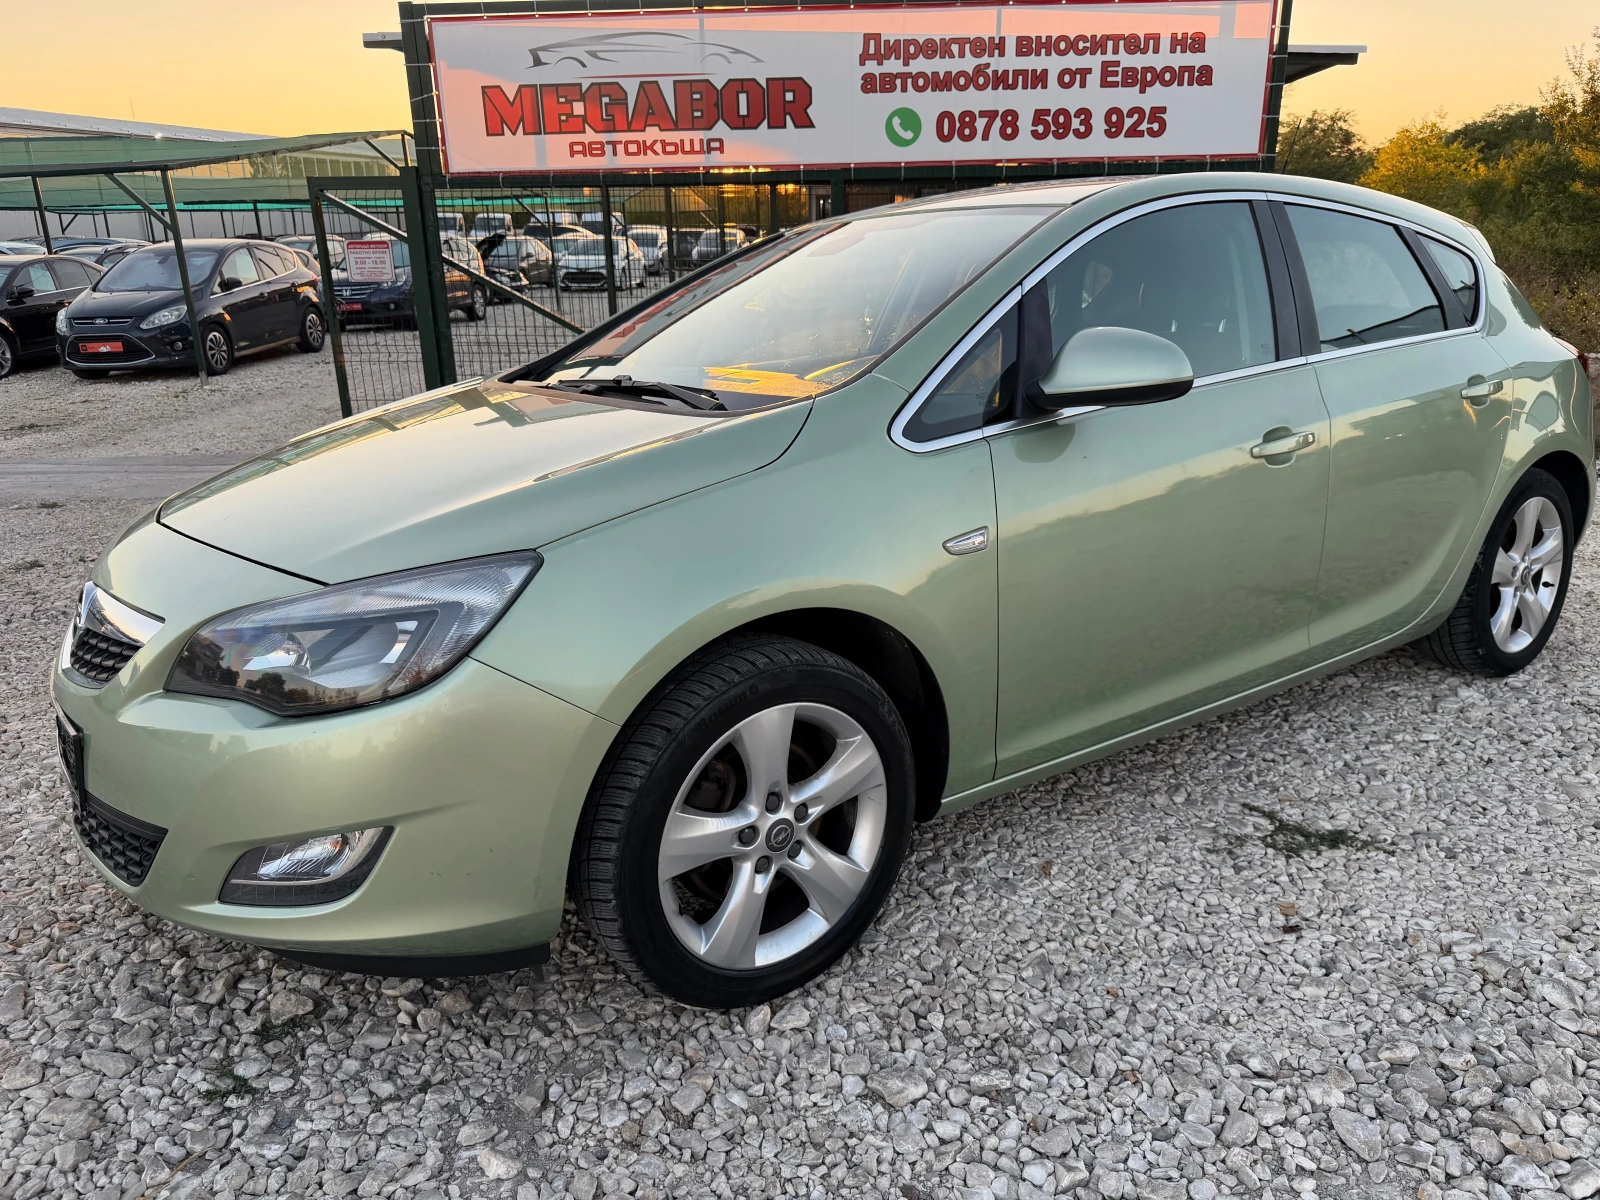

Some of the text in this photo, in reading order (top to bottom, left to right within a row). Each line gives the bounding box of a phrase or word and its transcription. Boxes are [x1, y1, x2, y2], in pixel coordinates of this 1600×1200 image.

[859, 32, 1207, 66] Директен вносител на
[860, 60, 1213, 94] автомобили от Европа
[481, 77, 816, 136] MEGABOR
[935, 106, 1168, 143] 0878 593 925
